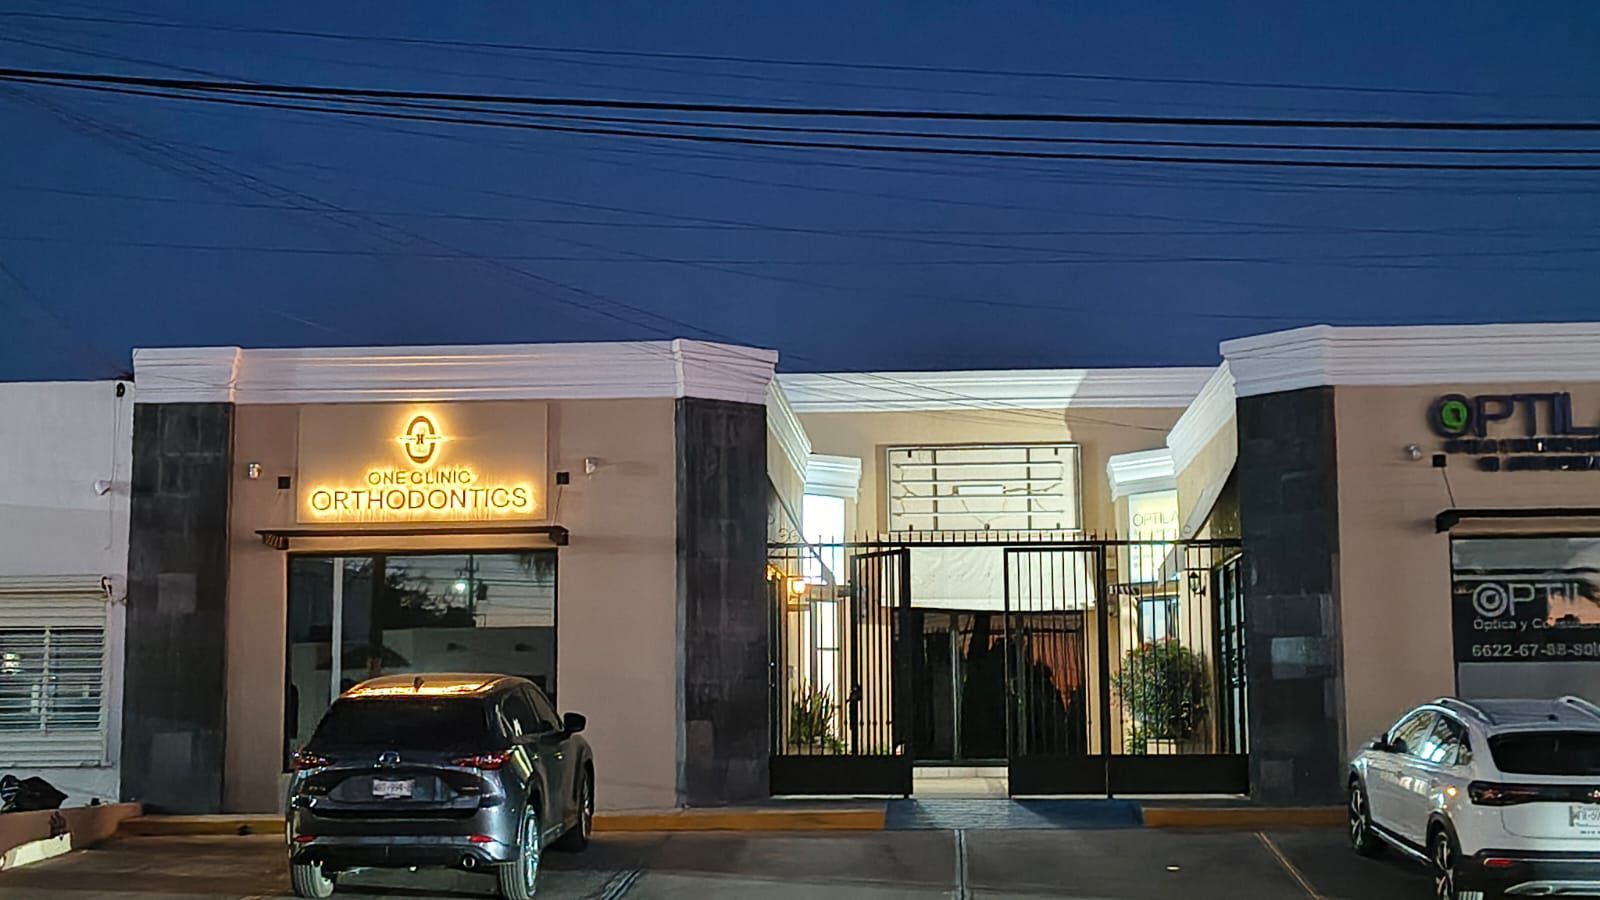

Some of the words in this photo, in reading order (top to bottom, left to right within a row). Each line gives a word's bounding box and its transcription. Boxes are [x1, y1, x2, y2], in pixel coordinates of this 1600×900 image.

[368, 471, 407, 485] ONE
[410, 470, 471, 484] CLINIC
[311, 487, 528, 511] ORTHODONTICS
